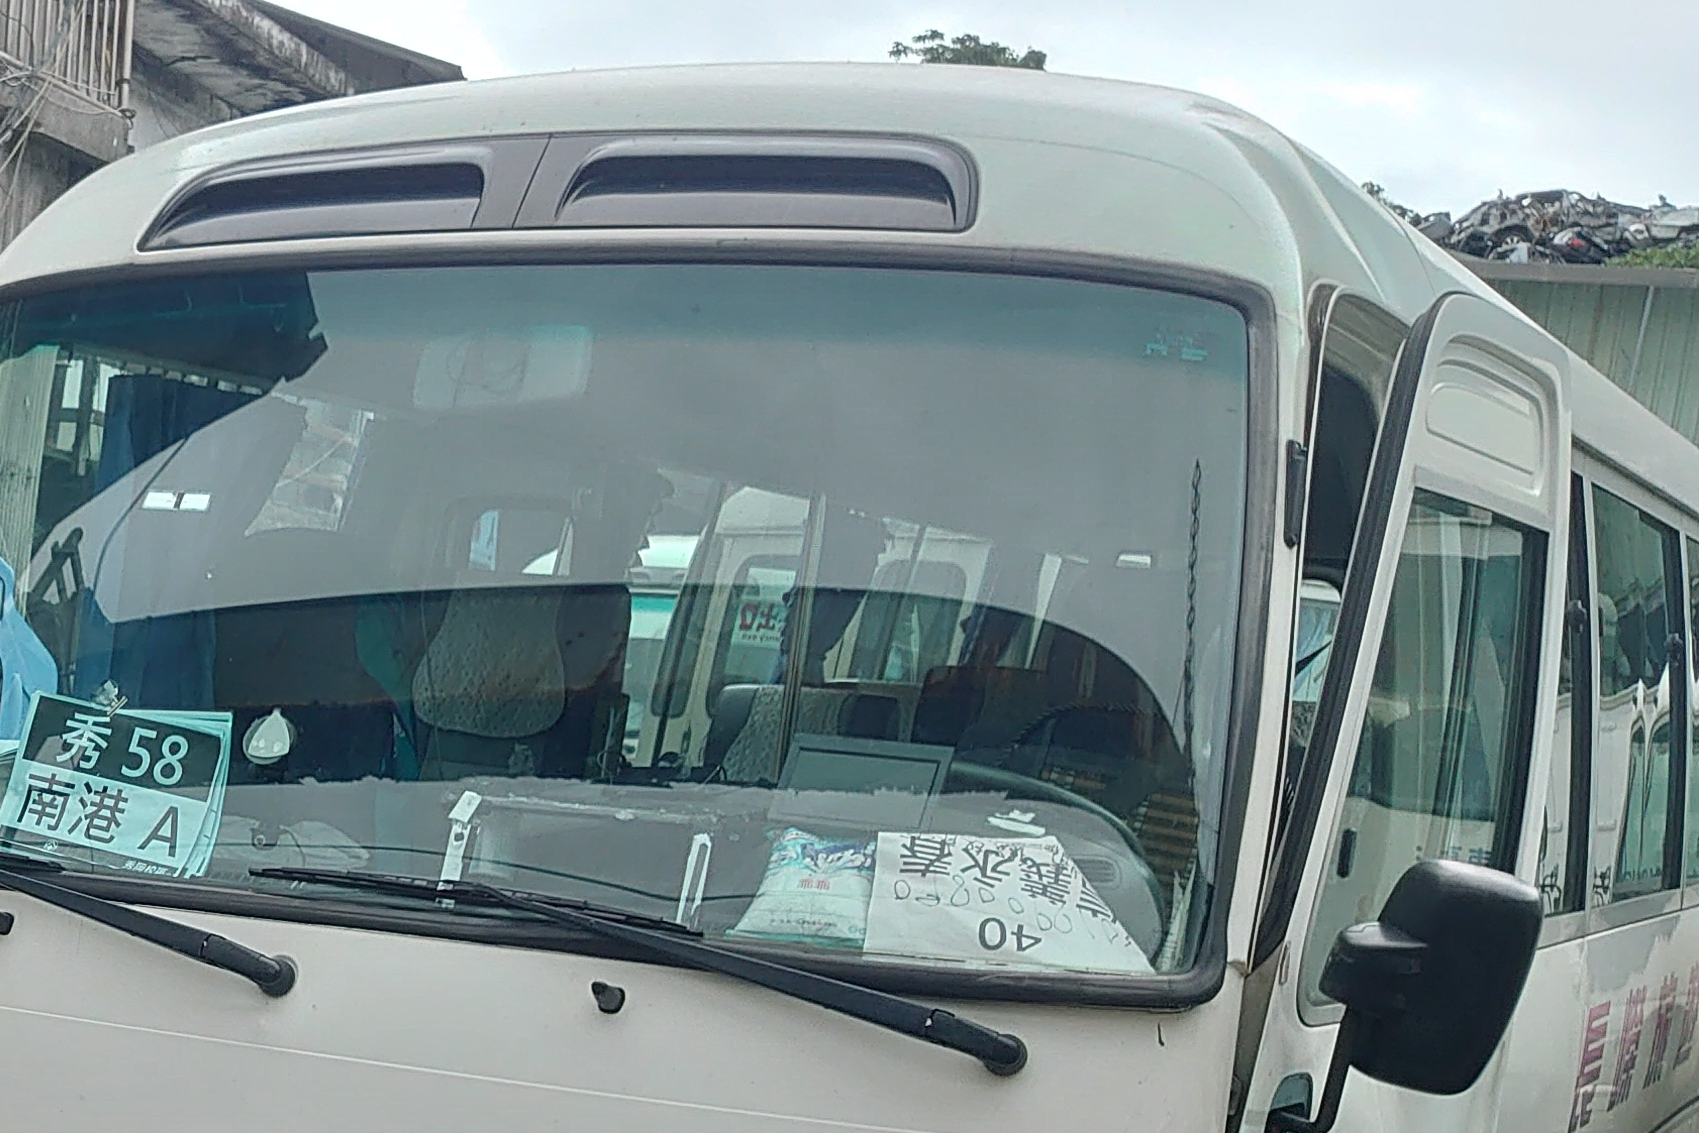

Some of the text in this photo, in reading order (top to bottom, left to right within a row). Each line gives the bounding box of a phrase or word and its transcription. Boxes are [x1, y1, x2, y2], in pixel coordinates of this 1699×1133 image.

[55, 712, 189, 786] 秀 58
[17, 773, 181, 858] 南港 A
[978, 916, 1043, 953] 40
